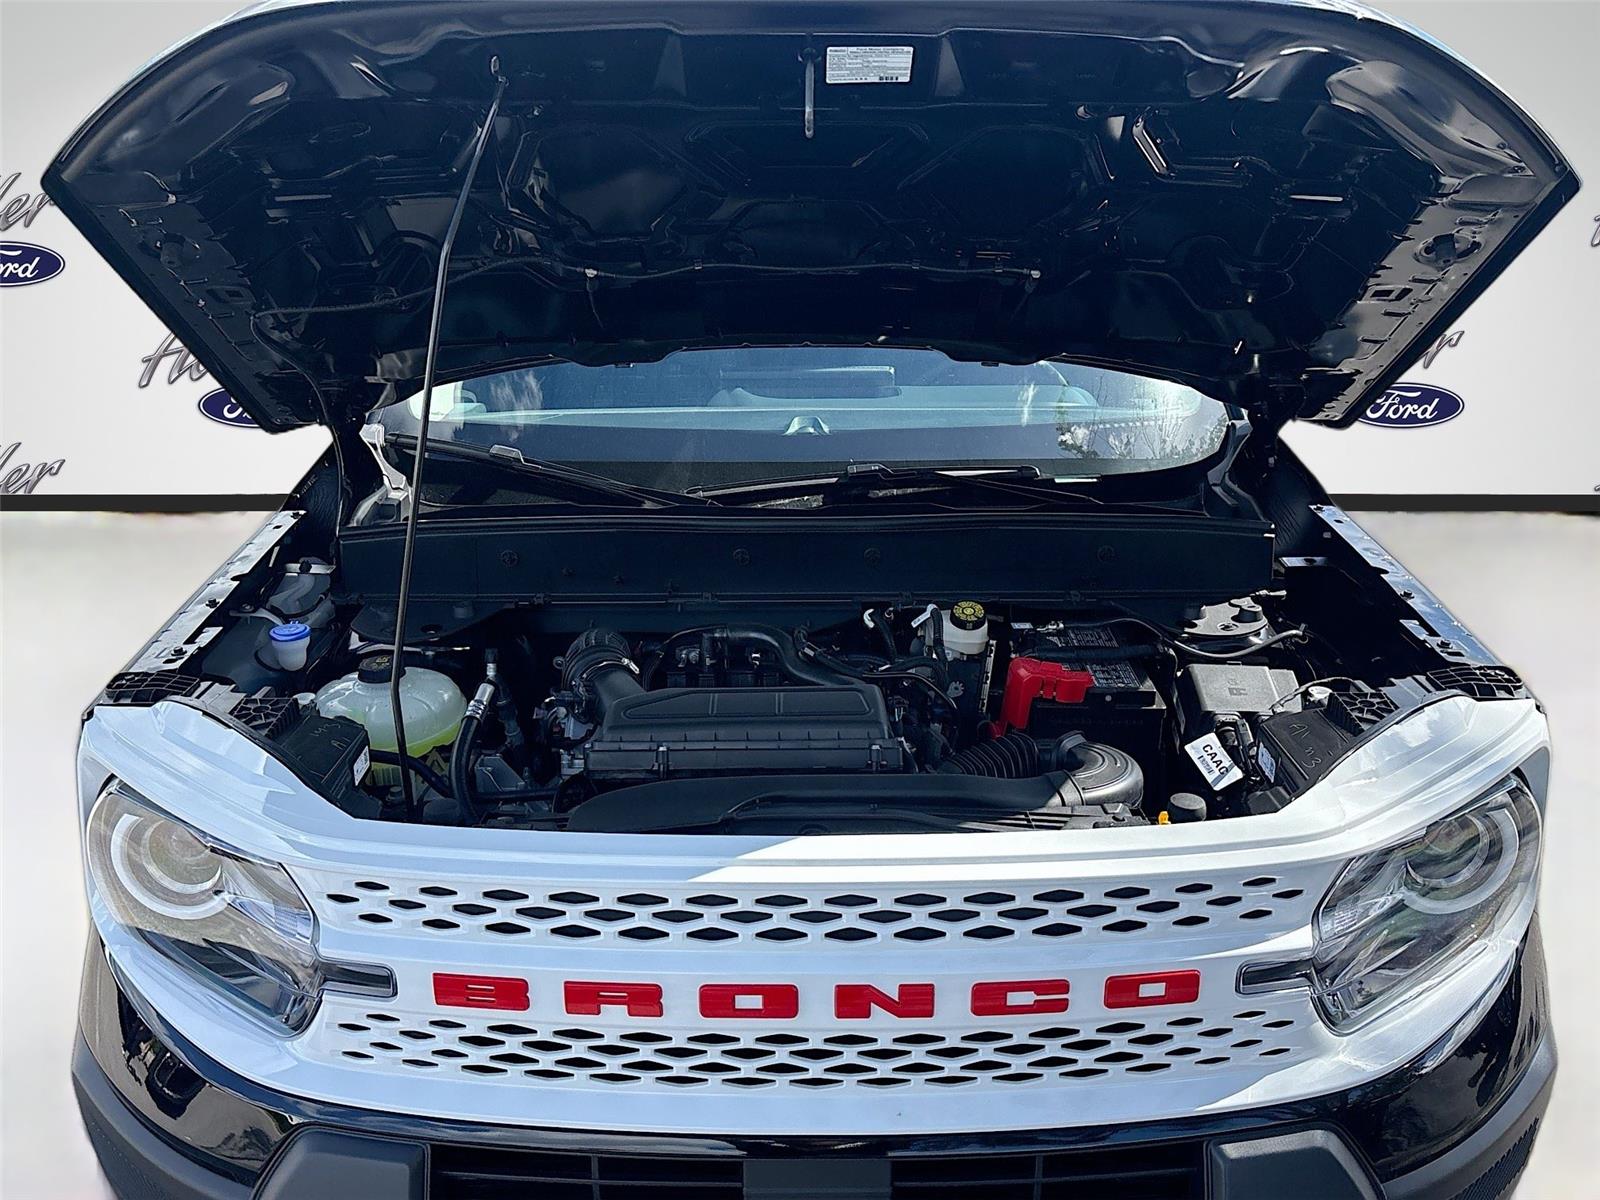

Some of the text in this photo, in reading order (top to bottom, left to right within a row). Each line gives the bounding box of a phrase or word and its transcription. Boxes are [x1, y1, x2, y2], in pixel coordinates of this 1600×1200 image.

[1366, 390, 1440, 419] Ford
[1202, 744, 1229, 775] CAAC
[433, 970, 1199, 1018] BRONCO
